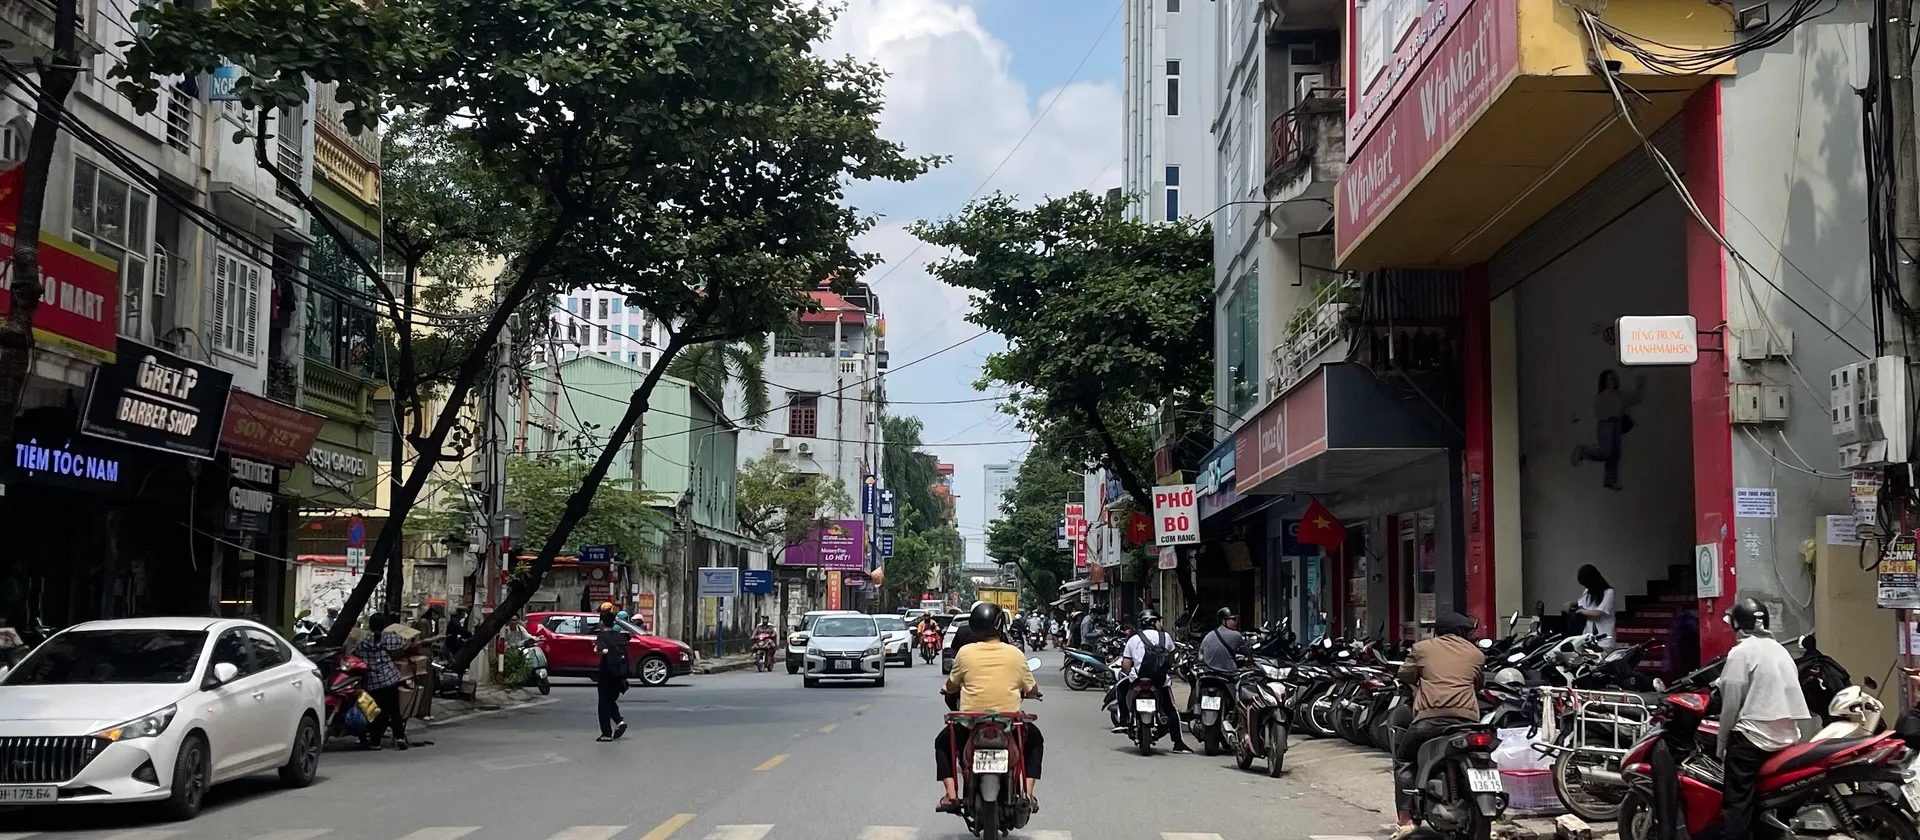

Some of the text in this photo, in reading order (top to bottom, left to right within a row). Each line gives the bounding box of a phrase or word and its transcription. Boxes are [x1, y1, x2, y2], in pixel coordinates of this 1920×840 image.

[60, 281, 104, 322] MART
[1631, 326, 1684, 340] TIẾNG TRUNG
[119, 396, 167, 430] BARBER
[167, 409, 198, 436] SHOP
[16, 437, 119, 482] TIỆM TÓC NAM
[331, 450, 369, 477] GARDEN
[229, 486, 273, 514] GAMING
[1155, 487, 1194, 509] PHỞ
[1164, 512, 1190, 532] BÒ
